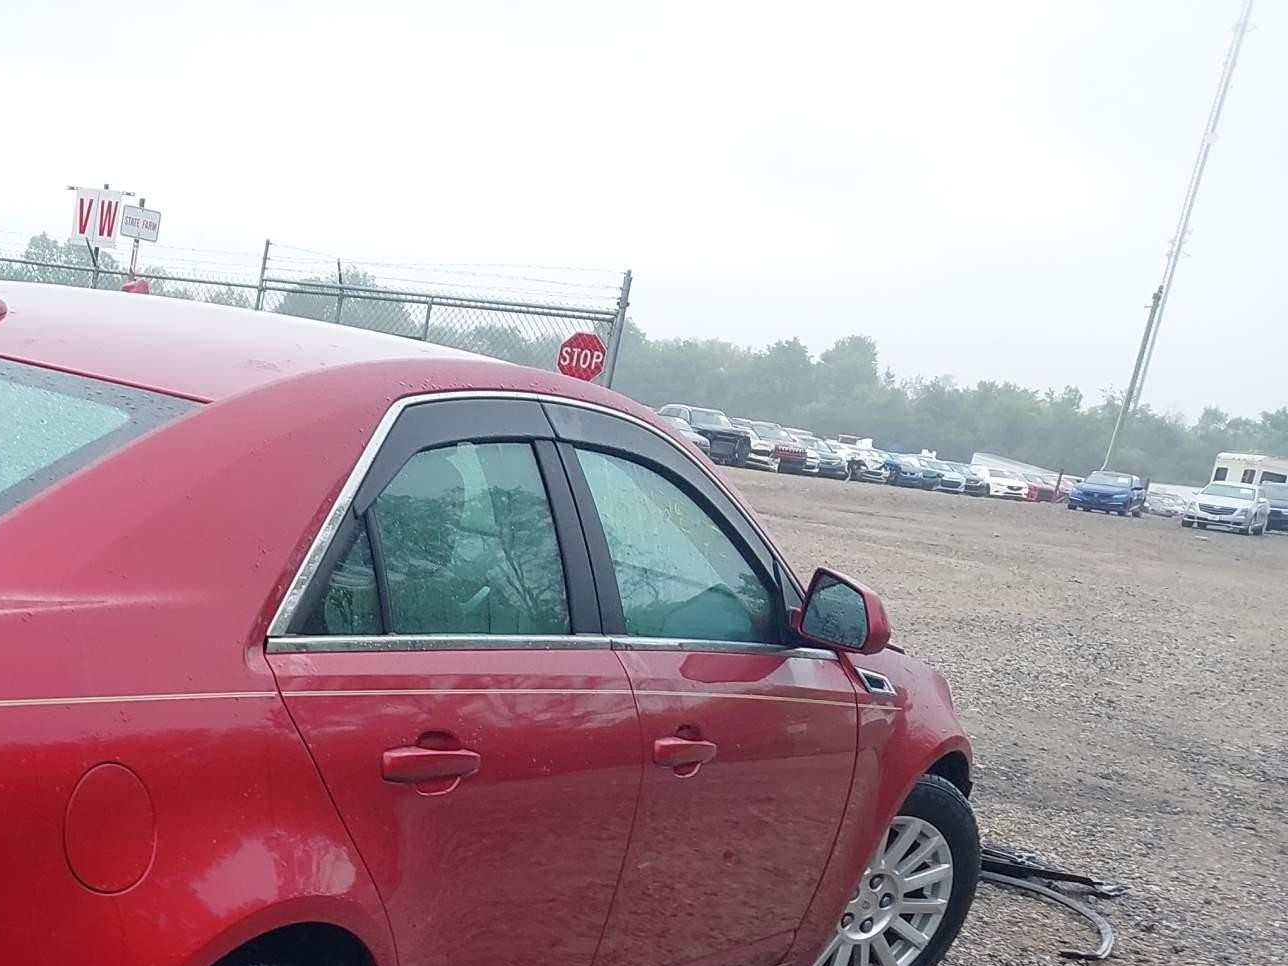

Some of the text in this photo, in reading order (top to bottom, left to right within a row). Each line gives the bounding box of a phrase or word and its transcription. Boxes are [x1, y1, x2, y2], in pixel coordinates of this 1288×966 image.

[124, 215, 158, 233] STATE FARM
[560, 347, 603, 370] STOP
